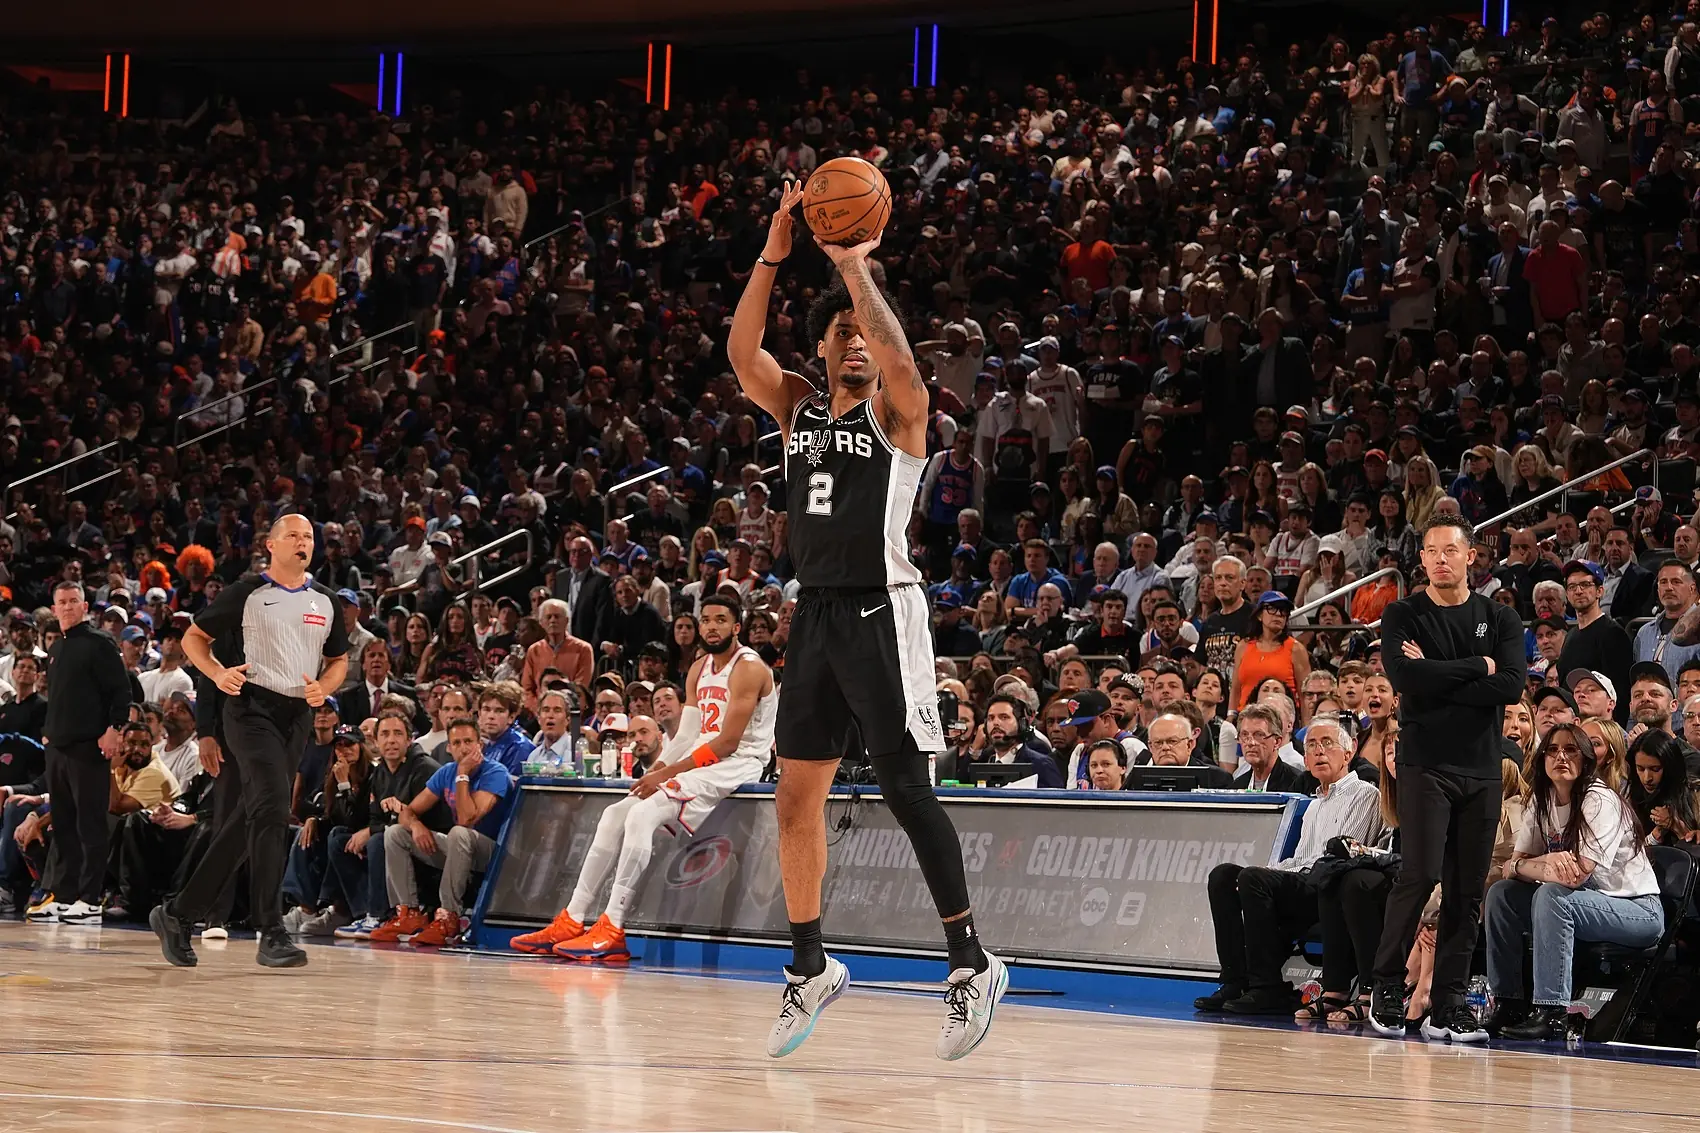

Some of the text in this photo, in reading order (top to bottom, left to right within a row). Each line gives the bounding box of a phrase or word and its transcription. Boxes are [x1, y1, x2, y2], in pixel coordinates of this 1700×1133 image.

[806, 471, 835, 516] 2
[1485, 534, 1498, 547] 107
[838, 828, 993, 873] HURRIES
[1026, 835, 1133, 879] GOLDEN
[879, 881, 894, 906] 4
[995, 887, 1012, 914] 8
[1011, 888, 1046, 916] PM
[1045, 889, 1075, 918] ET
